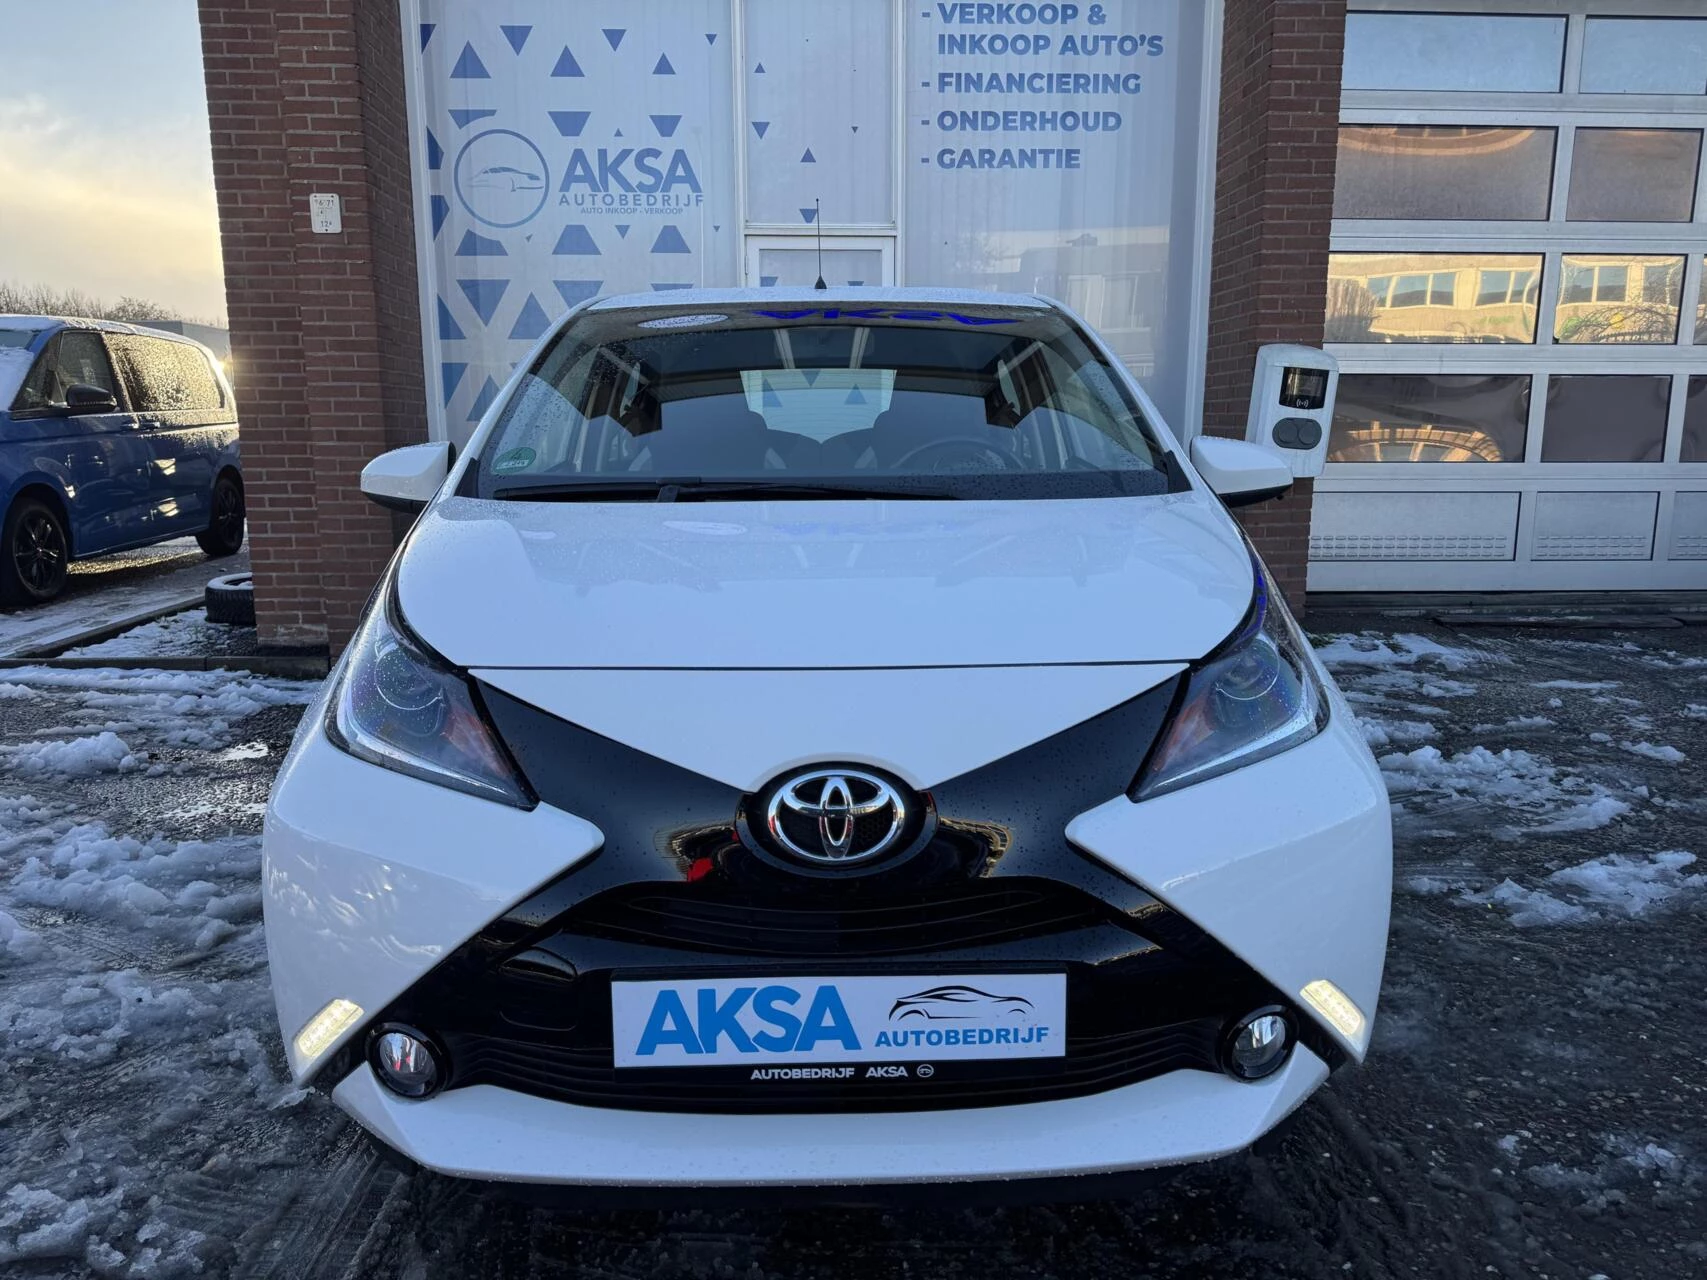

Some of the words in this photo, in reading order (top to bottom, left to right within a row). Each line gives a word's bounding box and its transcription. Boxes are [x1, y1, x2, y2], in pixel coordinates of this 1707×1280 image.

[937, 3, 1078, 24] VERKOOP
[1087, 3, 1106, 25] &
[938, 34, 1050, 55] INKOOP
[1059, 34, 1163, 56] AUTO'S
[938, 72, 1141, 94] FINANCIERING
[937, 110, 1122, 131] ONDERHOUD
[937, 148, 1080, 169] GARANTIE
[559, 148, 702, 193] AKSA
[559, 194, 704, 207] AUTOBEDRIJF
[635, 984, 862, 1056] AKSA
[874, 1027, 1049, 1048] AUTOBEDRIJF
[751, 1068, 854, 1080] AUTOBEDRIJF
[866, 1066, 908, 1077] AKSA
